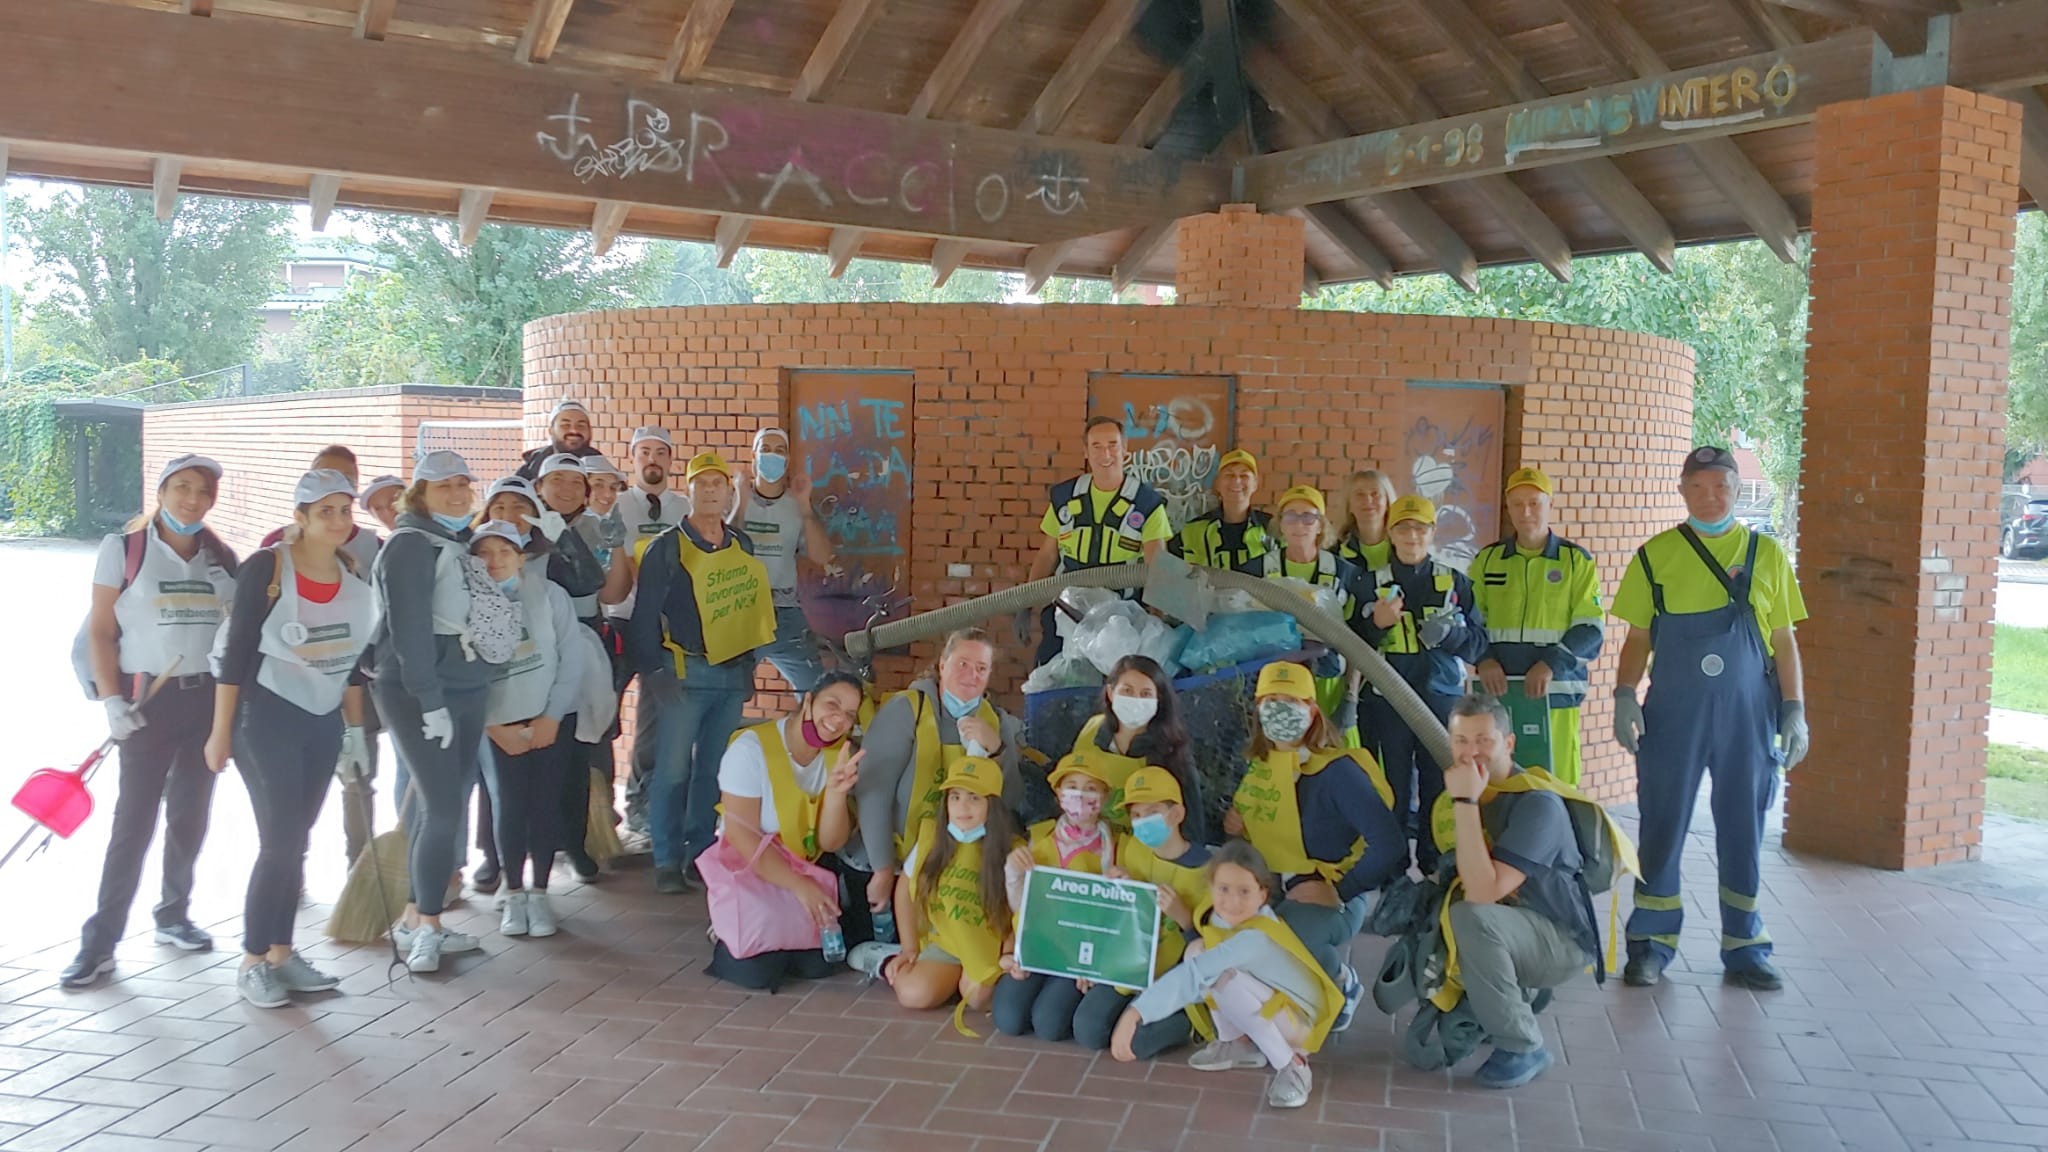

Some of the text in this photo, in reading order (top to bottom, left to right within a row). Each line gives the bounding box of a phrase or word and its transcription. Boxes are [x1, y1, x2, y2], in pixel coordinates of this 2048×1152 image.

[859, 398, 905, 438] TE
[706, 564, 748, 588] Stiamo
[705, 574, 759, 605] lavorando
[711, 605, 731, 624] per
[1051, 877, 1089, 896] Area
[1091, 883, 1137, 903] Pulita
